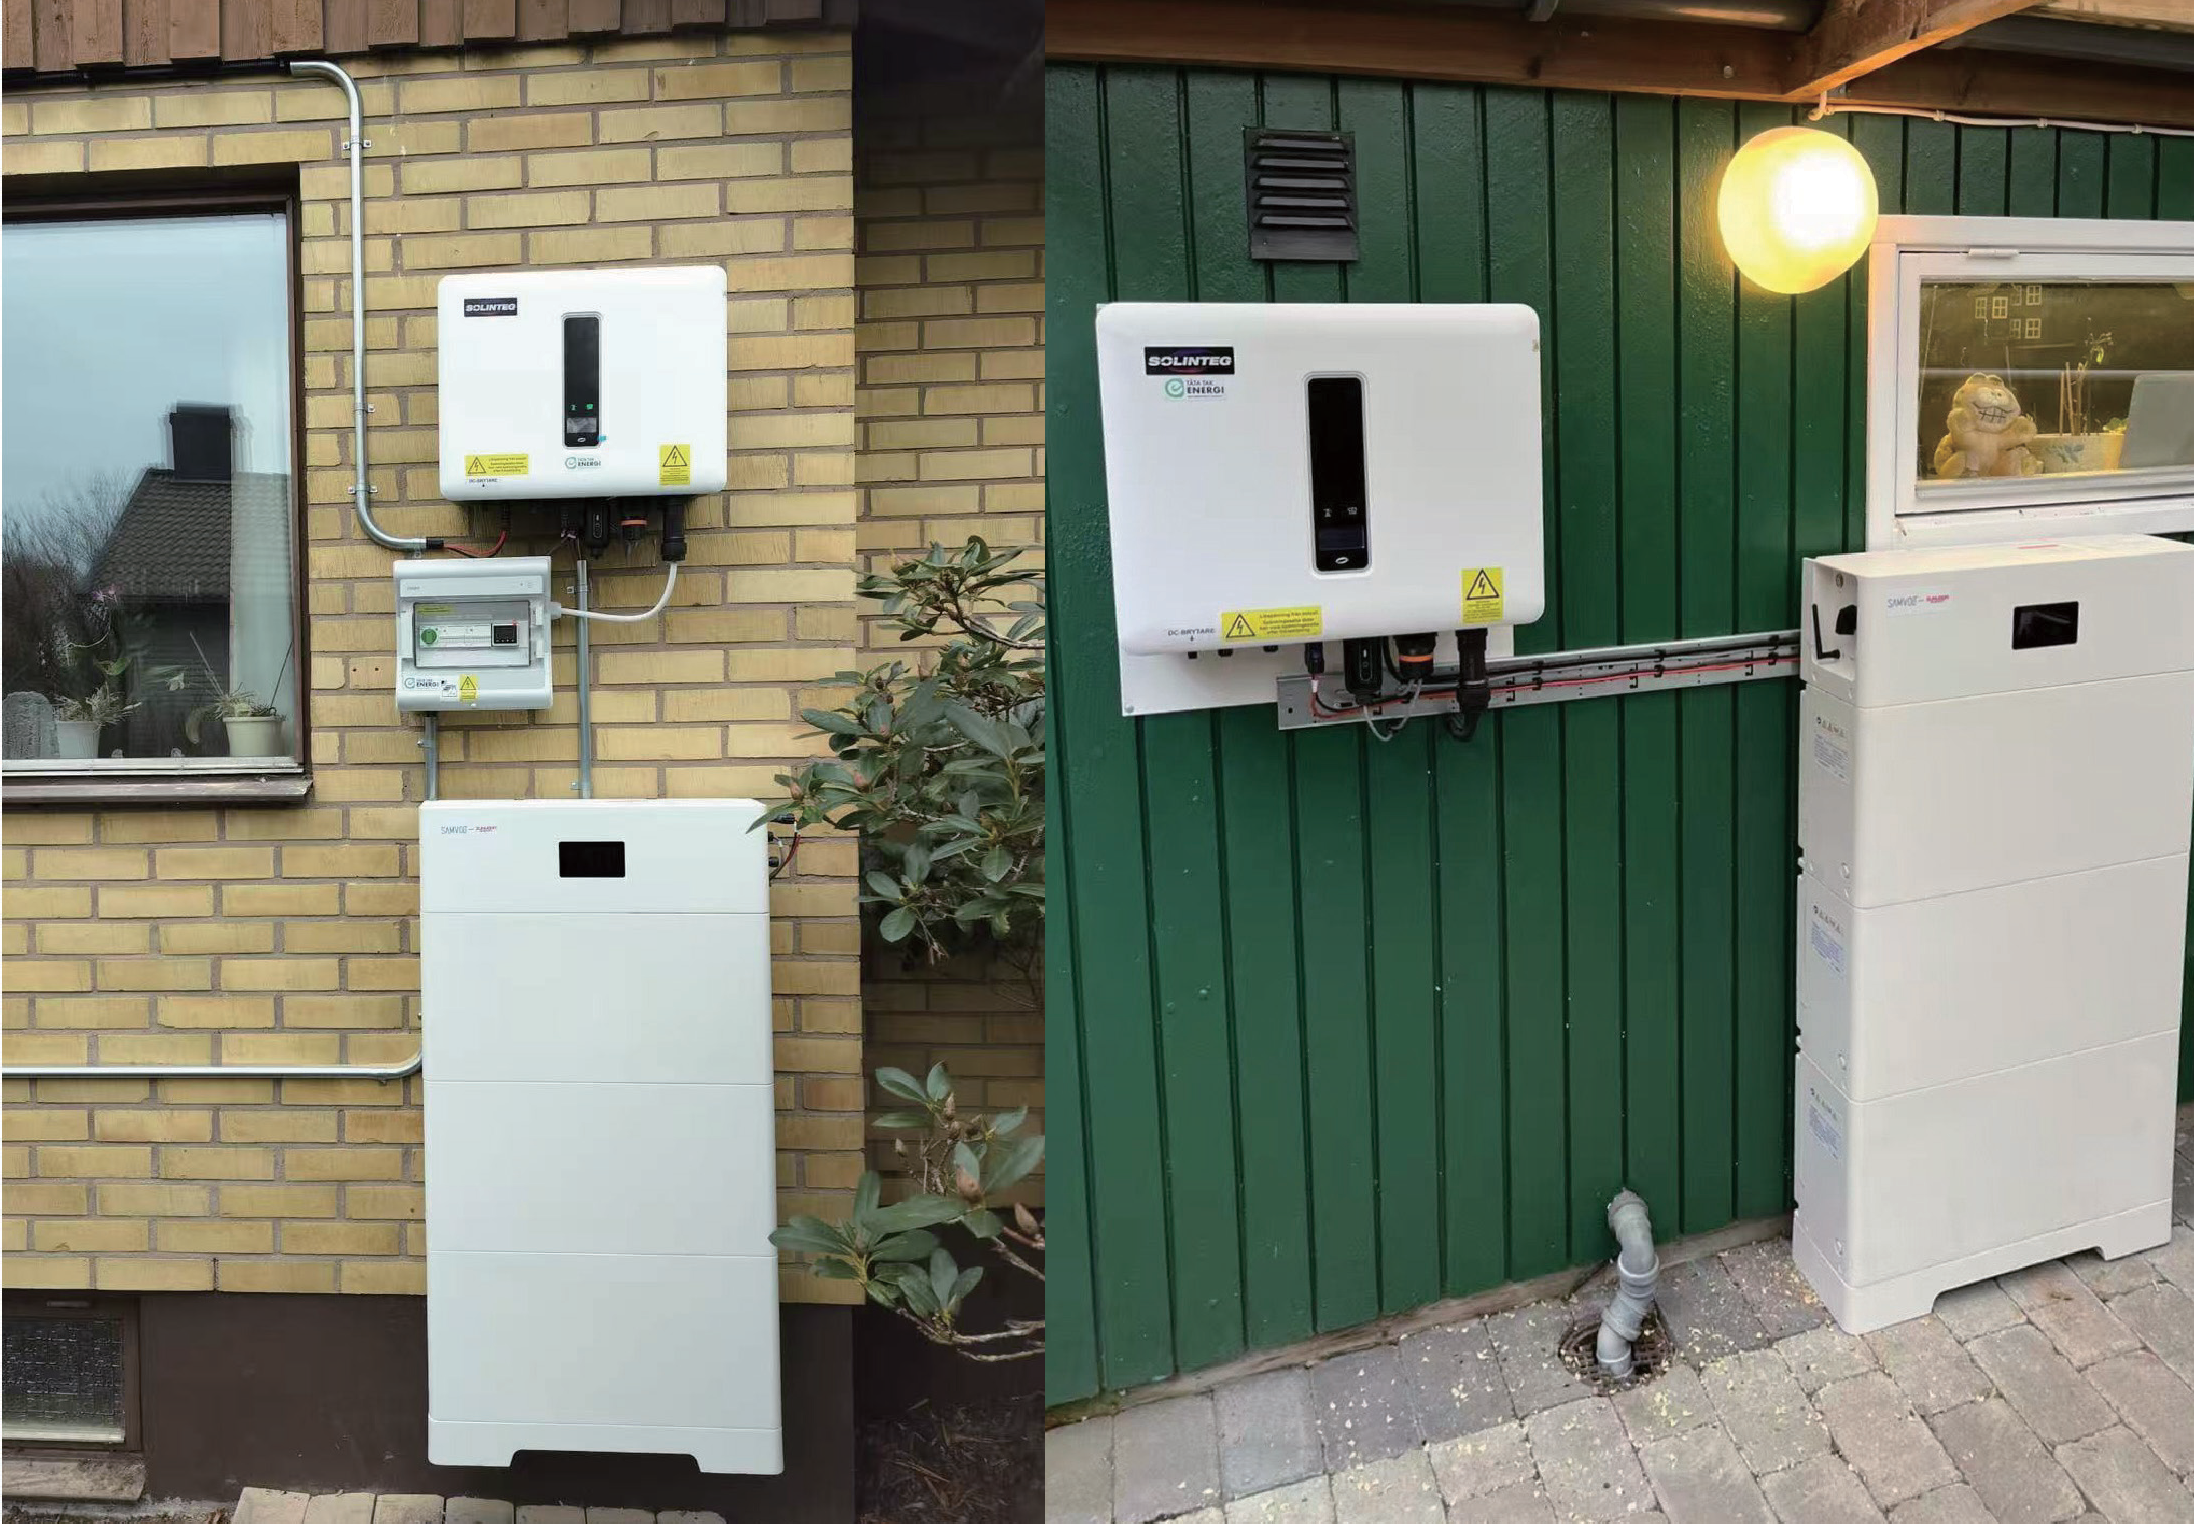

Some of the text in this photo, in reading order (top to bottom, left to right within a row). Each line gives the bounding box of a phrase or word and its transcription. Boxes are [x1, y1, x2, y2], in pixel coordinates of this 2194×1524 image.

[465, 303, 516, 312] SOLINTEG
[1148, 356, 1232, 367] SOLINTEG
[1187, 386, 1224, 394] ENERGI
